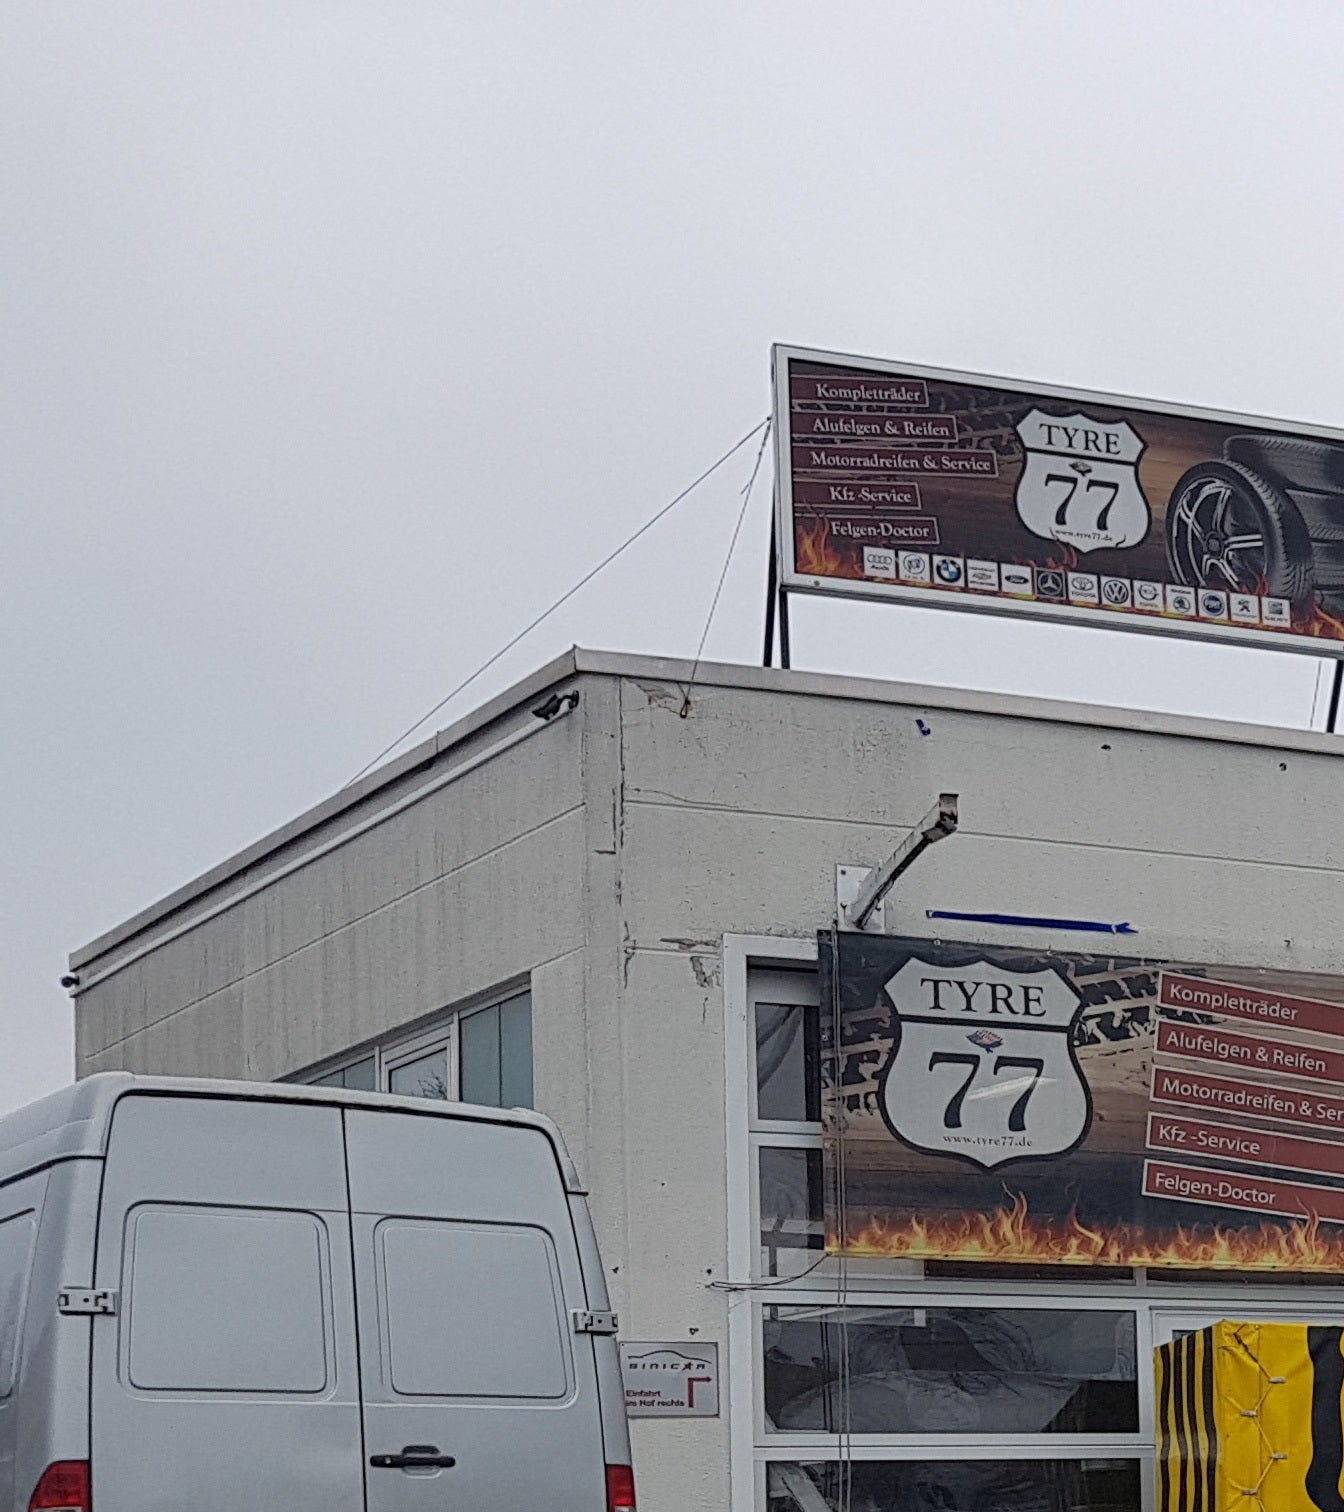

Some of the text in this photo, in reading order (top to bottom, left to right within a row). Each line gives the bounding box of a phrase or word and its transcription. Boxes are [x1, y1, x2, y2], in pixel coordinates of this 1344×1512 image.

[816, 383, 921, 402] Kompletträder
[813, 418, 950, 436] Alufelgen & Reifen
[1039, 423, 1121, 455] TYRE
[811, 451, 991, 471] Motorradreifen & Service
[1045, 473, 1119, 531] 77
[831, 521, 930, 538] Felgen-Doctor
[920, 977, 1047, 1017] TYRE
[1169, 983, 1298, 1020] Kompletträder
[1166, 1031, 1326, 1072] Alufelgen & Reifen
[928, 1051, 1045, 1132] 77
[1162, 1077, 1295, 1113] Motorradreifen
[1299, 1100, 1312, 1116] &
[942, 1134, 1033, 1148] www.tyre77.de
[1159, 1124, 1187, 1143] Kfz
[1154, 1172, 1276, 1205] Felgen-Doctor
[626, 1389, 661, 1397] Einfahrt
[639, 1399, 655, 1407] Hof
[657, 1399, 685, 1407] rechts
